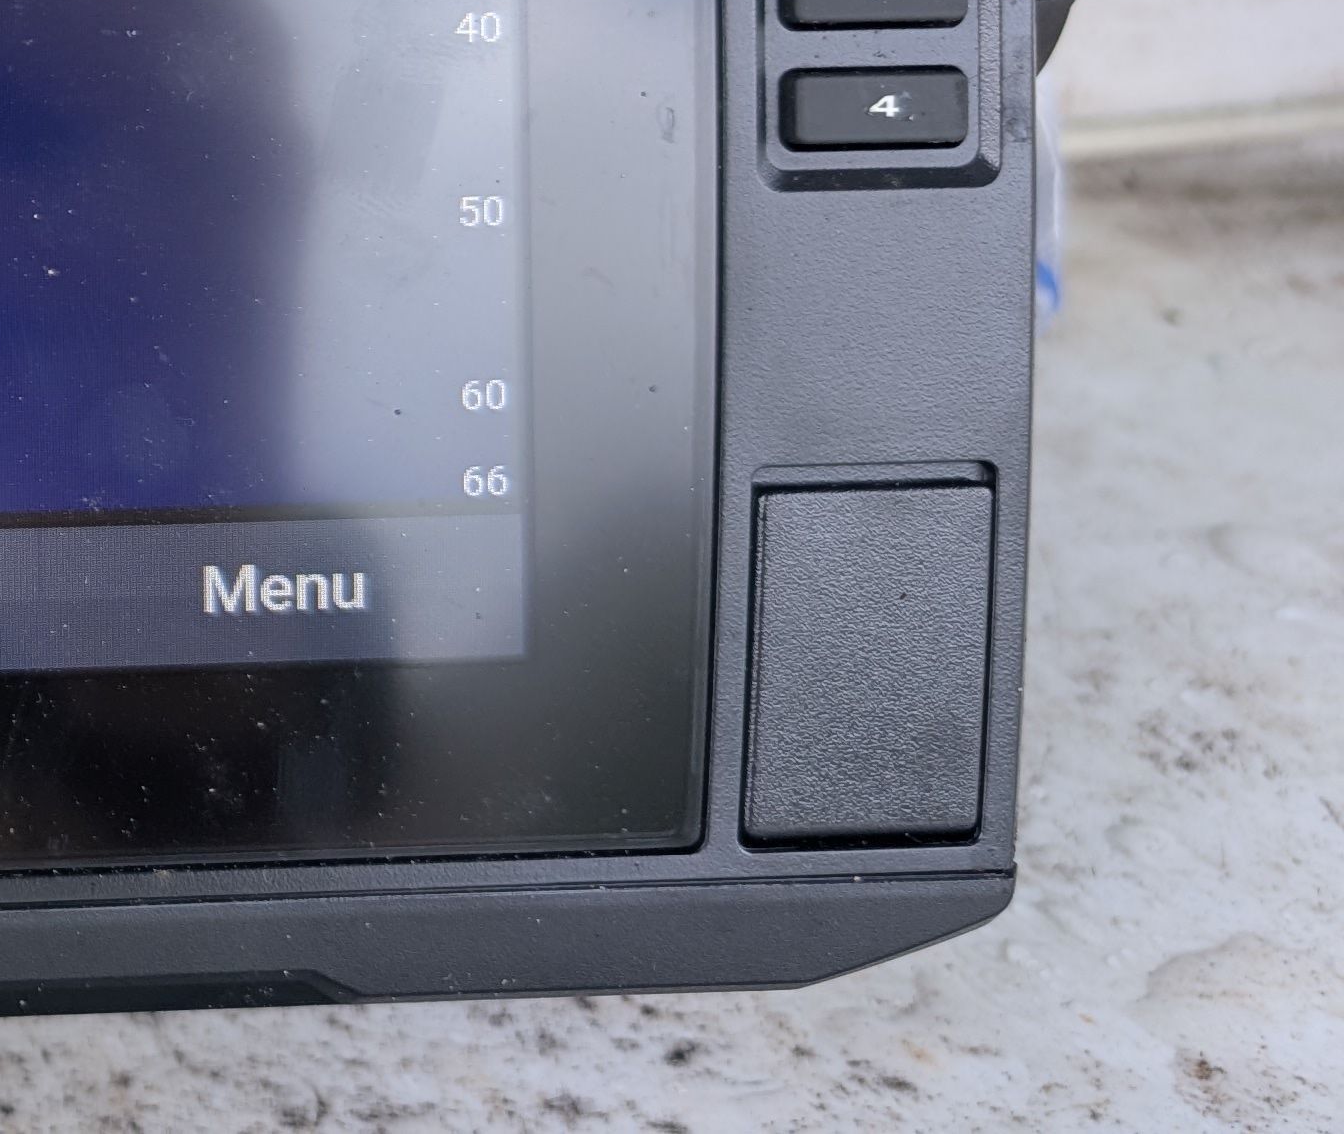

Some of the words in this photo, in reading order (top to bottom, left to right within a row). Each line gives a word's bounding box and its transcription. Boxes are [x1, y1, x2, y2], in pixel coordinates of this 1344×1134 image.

[454, 11, 501, 44] 40
[869, 94, 901, 118] 4
[458, 195, 505, 227] 50
[461, 379, 507, 411] 60
[463, 465, 510, 497] 66
[202, 563, 368, 616] Menu
